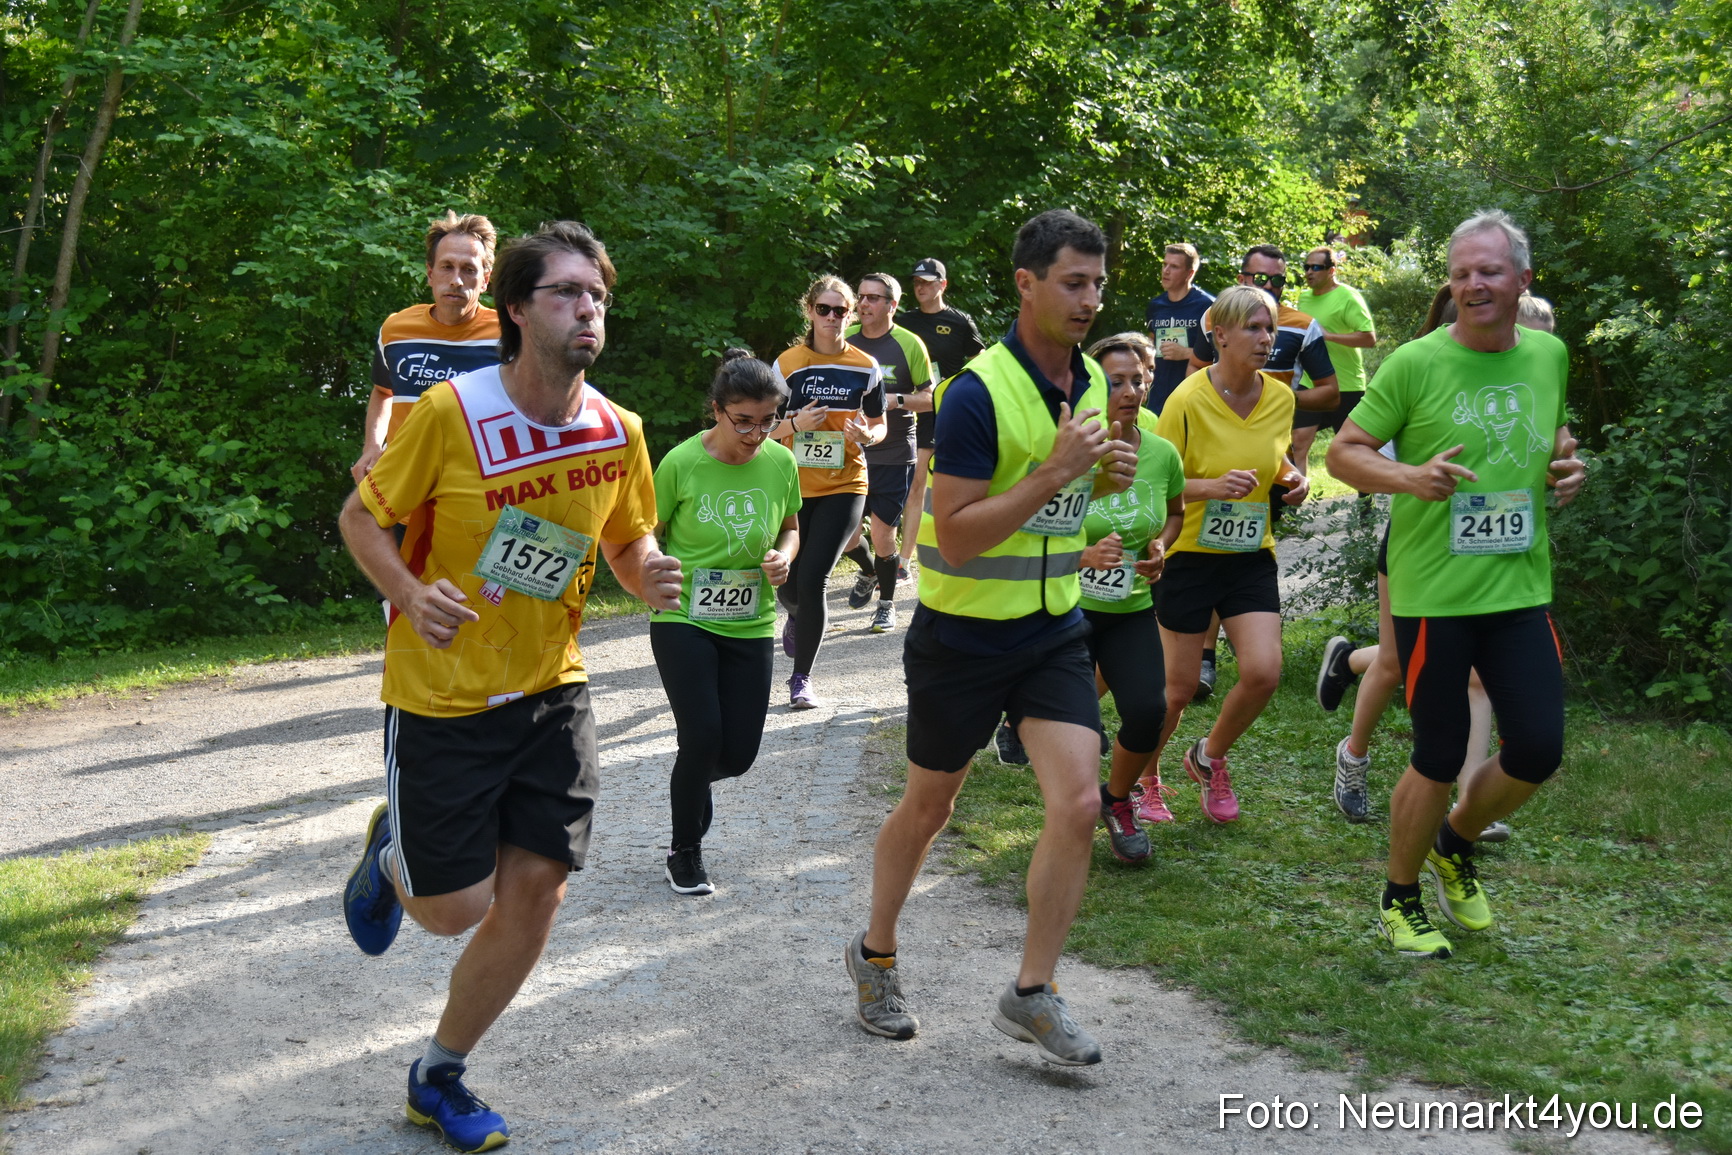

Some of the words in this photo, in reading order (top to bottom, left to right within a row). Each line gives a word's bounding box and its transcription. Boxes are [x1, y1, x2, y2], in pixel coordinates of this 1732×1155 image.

[1154, 319, 1170, 327] EURO
[1175, 319, 1197, 327] POLES
[408, 364, 470, 381] Fische
[805, 384, 851, 395] Fischer
[803, 444, 833, 458] 752
[484, 473, 559, 512] MAX
[566, 459, 628, 492] BÖGL
[1042, 493, 1084, 518] 510
[1207, 517, 1258, 538] 2015
[1460, 512, 1523, 537] 2419
[1468, 536, 1503, 545] Schmiedel
[1503, 535, 1527, 543] Michael
[500, 537, 568, 582] 1572
[490, 569, 500, 577] Max
[493, 561, 523, 579] Gebhard
[523, 573, 555, 590] Johannes
[1079, 567, 1126, 589] 422
[698, 587, 753, 606] 2420
